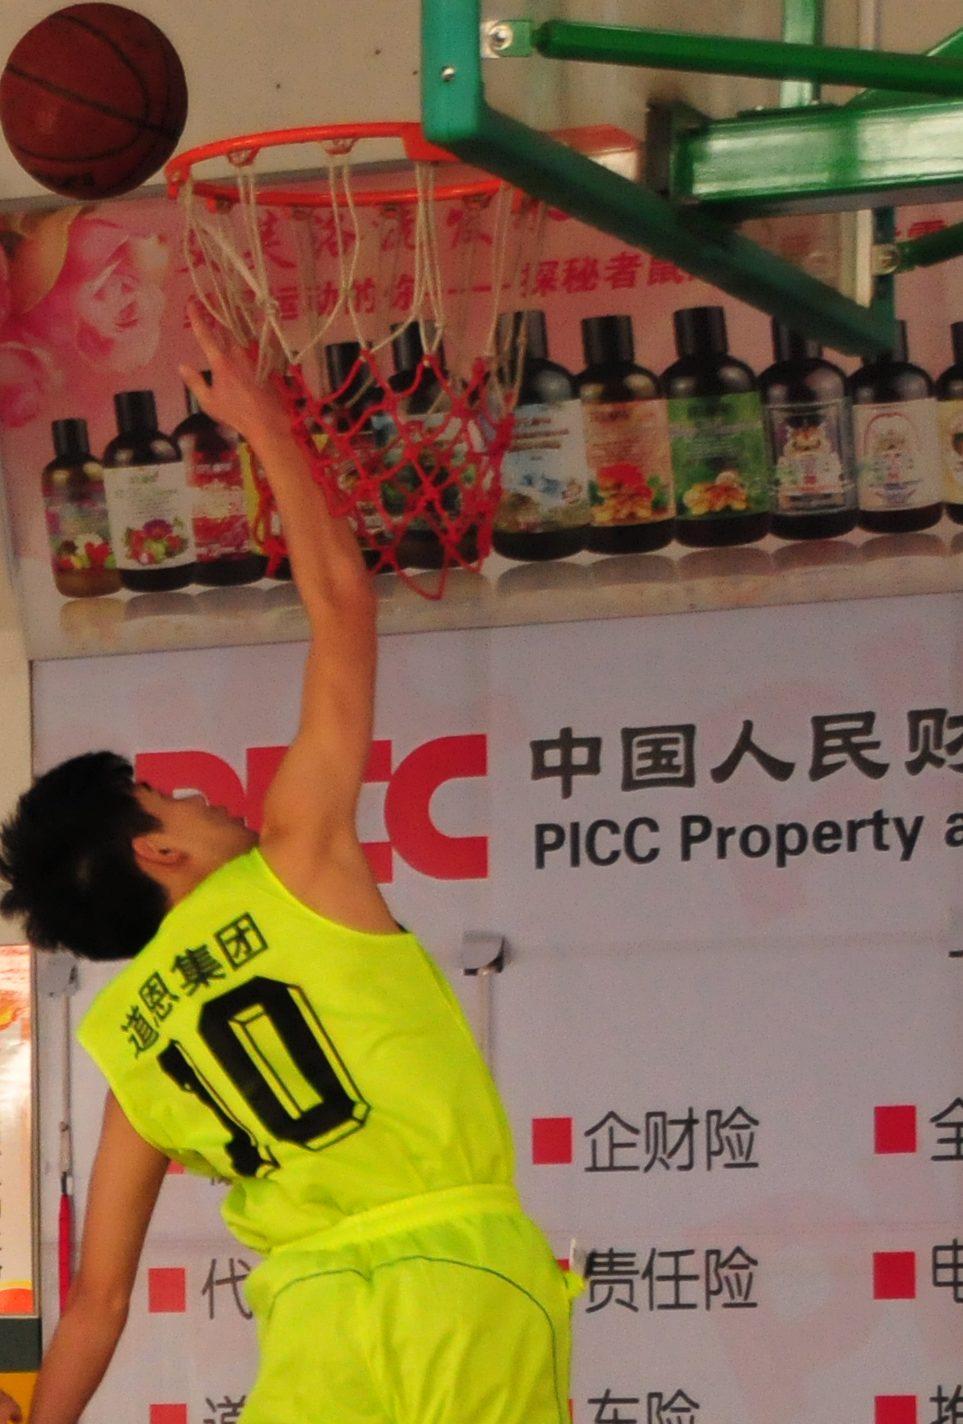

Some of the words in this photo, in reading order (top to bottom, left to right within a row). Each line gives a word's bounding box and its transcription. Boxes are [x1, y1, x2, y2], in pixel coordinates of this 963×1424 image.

[535, 816, 661, 870] PICC
[680, 808, 925, 869] Property
[121, 911, 269, 1059] 道恩集团
[156, 975, 371, 1180] 10
[583, 1106, 760, 1174] 企财险
[585, 1245, 759, 1313] 责任险
